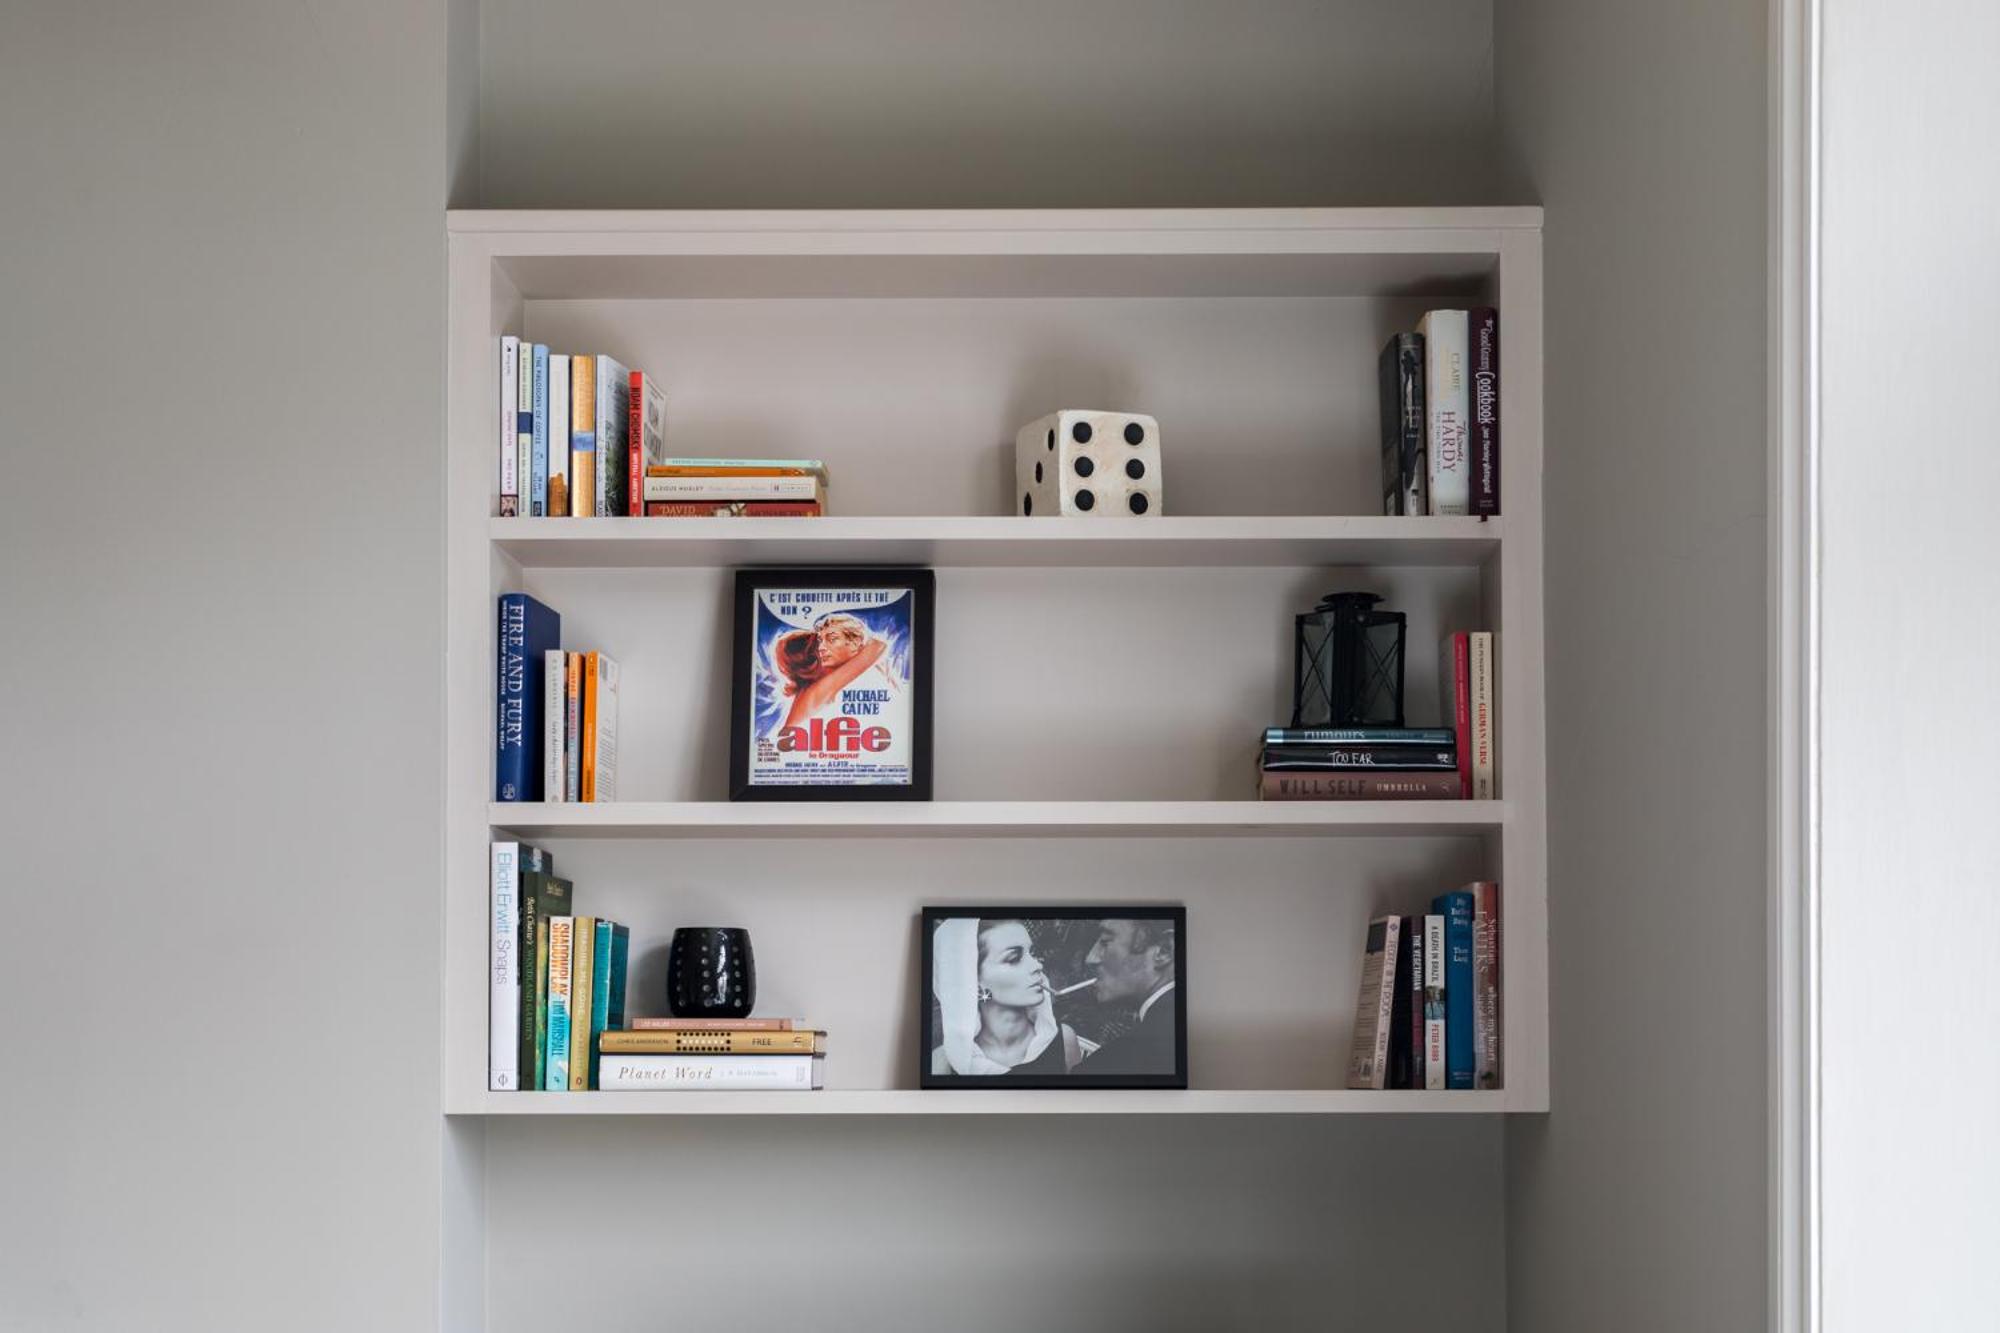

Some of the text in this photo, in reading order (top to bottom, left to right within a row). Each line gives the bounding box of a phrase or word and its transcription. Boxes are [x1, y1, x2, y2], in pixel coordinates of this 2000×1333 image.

[1451, 352, 1461, 392] CLAIRE
[631, 387, 642, 410] NOAM
[1475, 371, 1496, 425] Cookbook
[631, 413, 641, 450] CHOMSKY
[1442, 410, 1456, 474] HARDY
[1456, 420, 1467, 463] Thomas
[659, 504, 696, 515] DAVID
[769, 592, 792, 603] C'EST
[795, 592, 833, 603] CHOUETTE
[863, 592, 874, 603] LE
[780, 605, 797, 616] NON
[506, 604, 524, 747] FIRE AND FURY
[842, 689, 891, 702] MICHAEL
[842, 703, 879, 715] CAINE
[777, 716, 892, 753] alfie
[1478, 703, 1486, 739] GERMAN
[1351, 752, 1375, 767] FAR
[1479, 740, 1488, 768] VERSE
[1279, 779, 1427, 795] WILL SELF UMBRELLA
[494, 852, 513, 984] Elliott Erwitt Snaps
[526, 896, 536, 914] Beth
[1431, 932, 1440, 952] DEATH
[1475, 910, 1488, 973] FAULKS
[1487, 917, 1497, 965] Sebastian
[525, 949, 535, 1002] WOODLAND
[1412, 935, 1422, 992] THE VEGETARIAN
[1431, 960, 1440, 983] BRAZIL
[550, 922, 570, 1057] SHADOWPLAY TIM MARSHALL
[525, 1004, 534, 1041] GARDEN
[1431, 1024, 1441, 1044] PETER
[1486, 986, 1497, 1061] where my heart
[751, 1038, 772, 1046] FREE
[618, 1066, 667, 1080] Planet
[674, 1066, 714, 1080] Word
